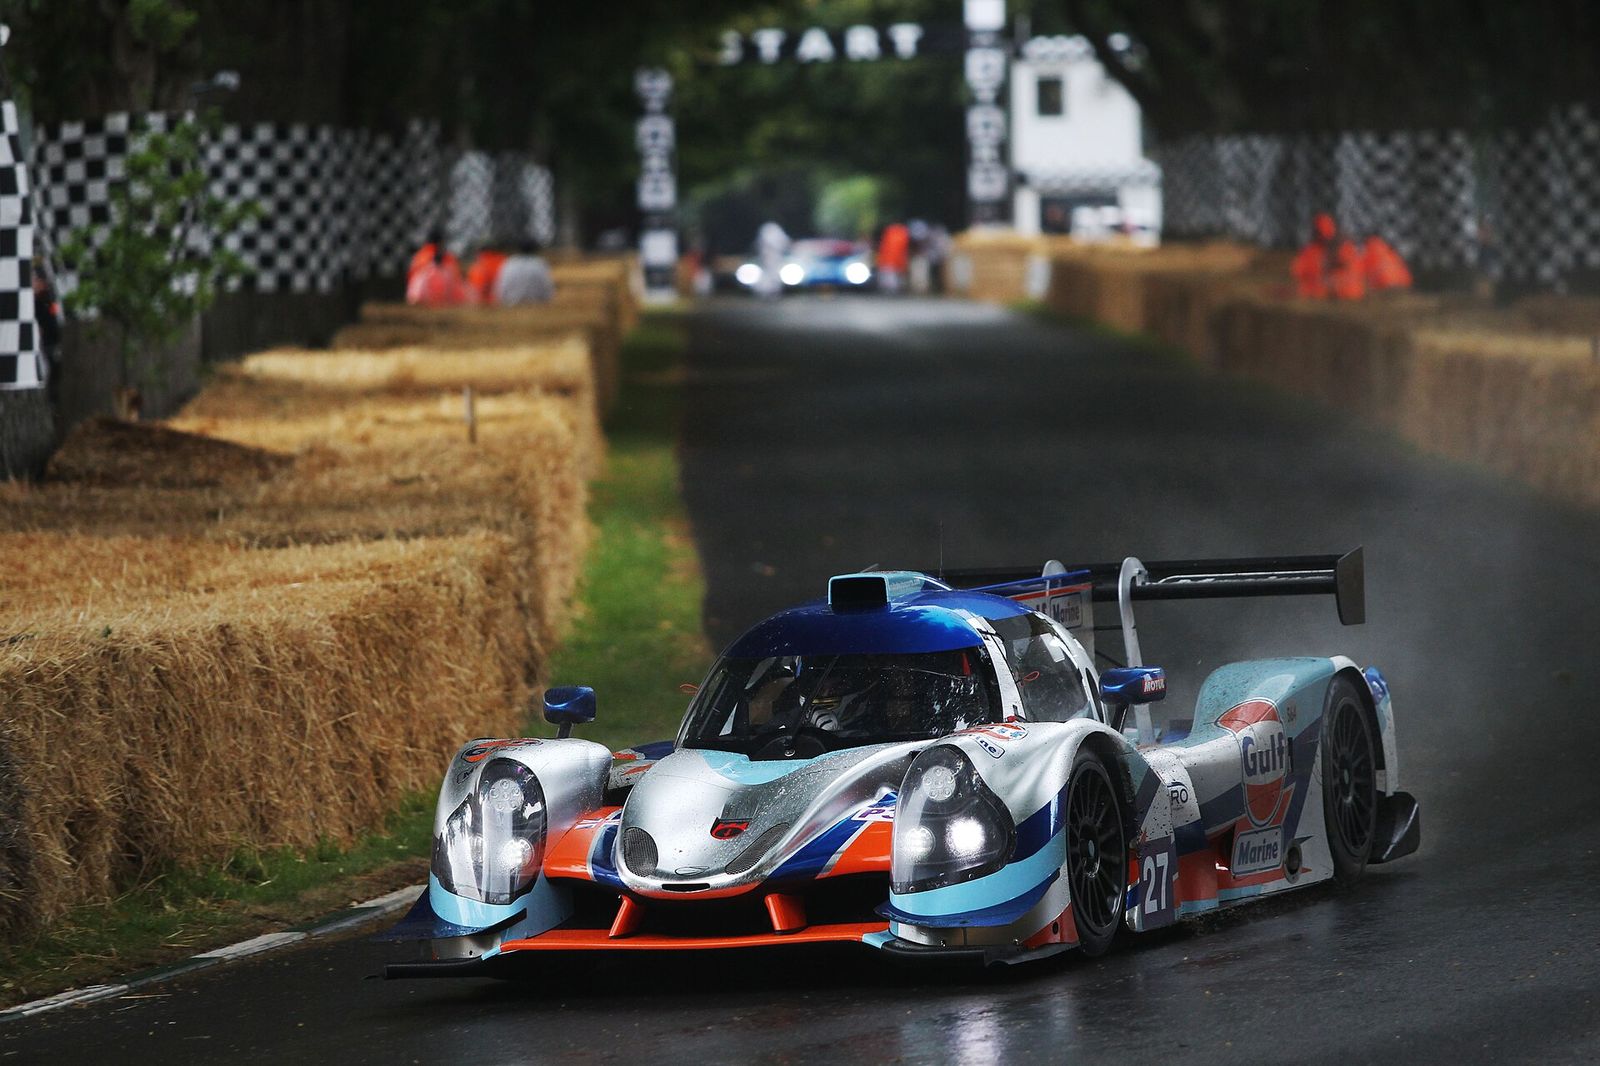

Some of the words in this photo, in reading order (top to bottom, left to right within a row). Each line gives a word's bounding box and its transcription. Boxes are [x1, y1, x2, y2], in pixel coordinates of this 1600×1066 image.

[719, 22, 924, 66] START
[1242, 731, 1285, 777] Gulf
[1237, 837, 1279, 866] Marine
[1143, 851, 1169, 914] 27
